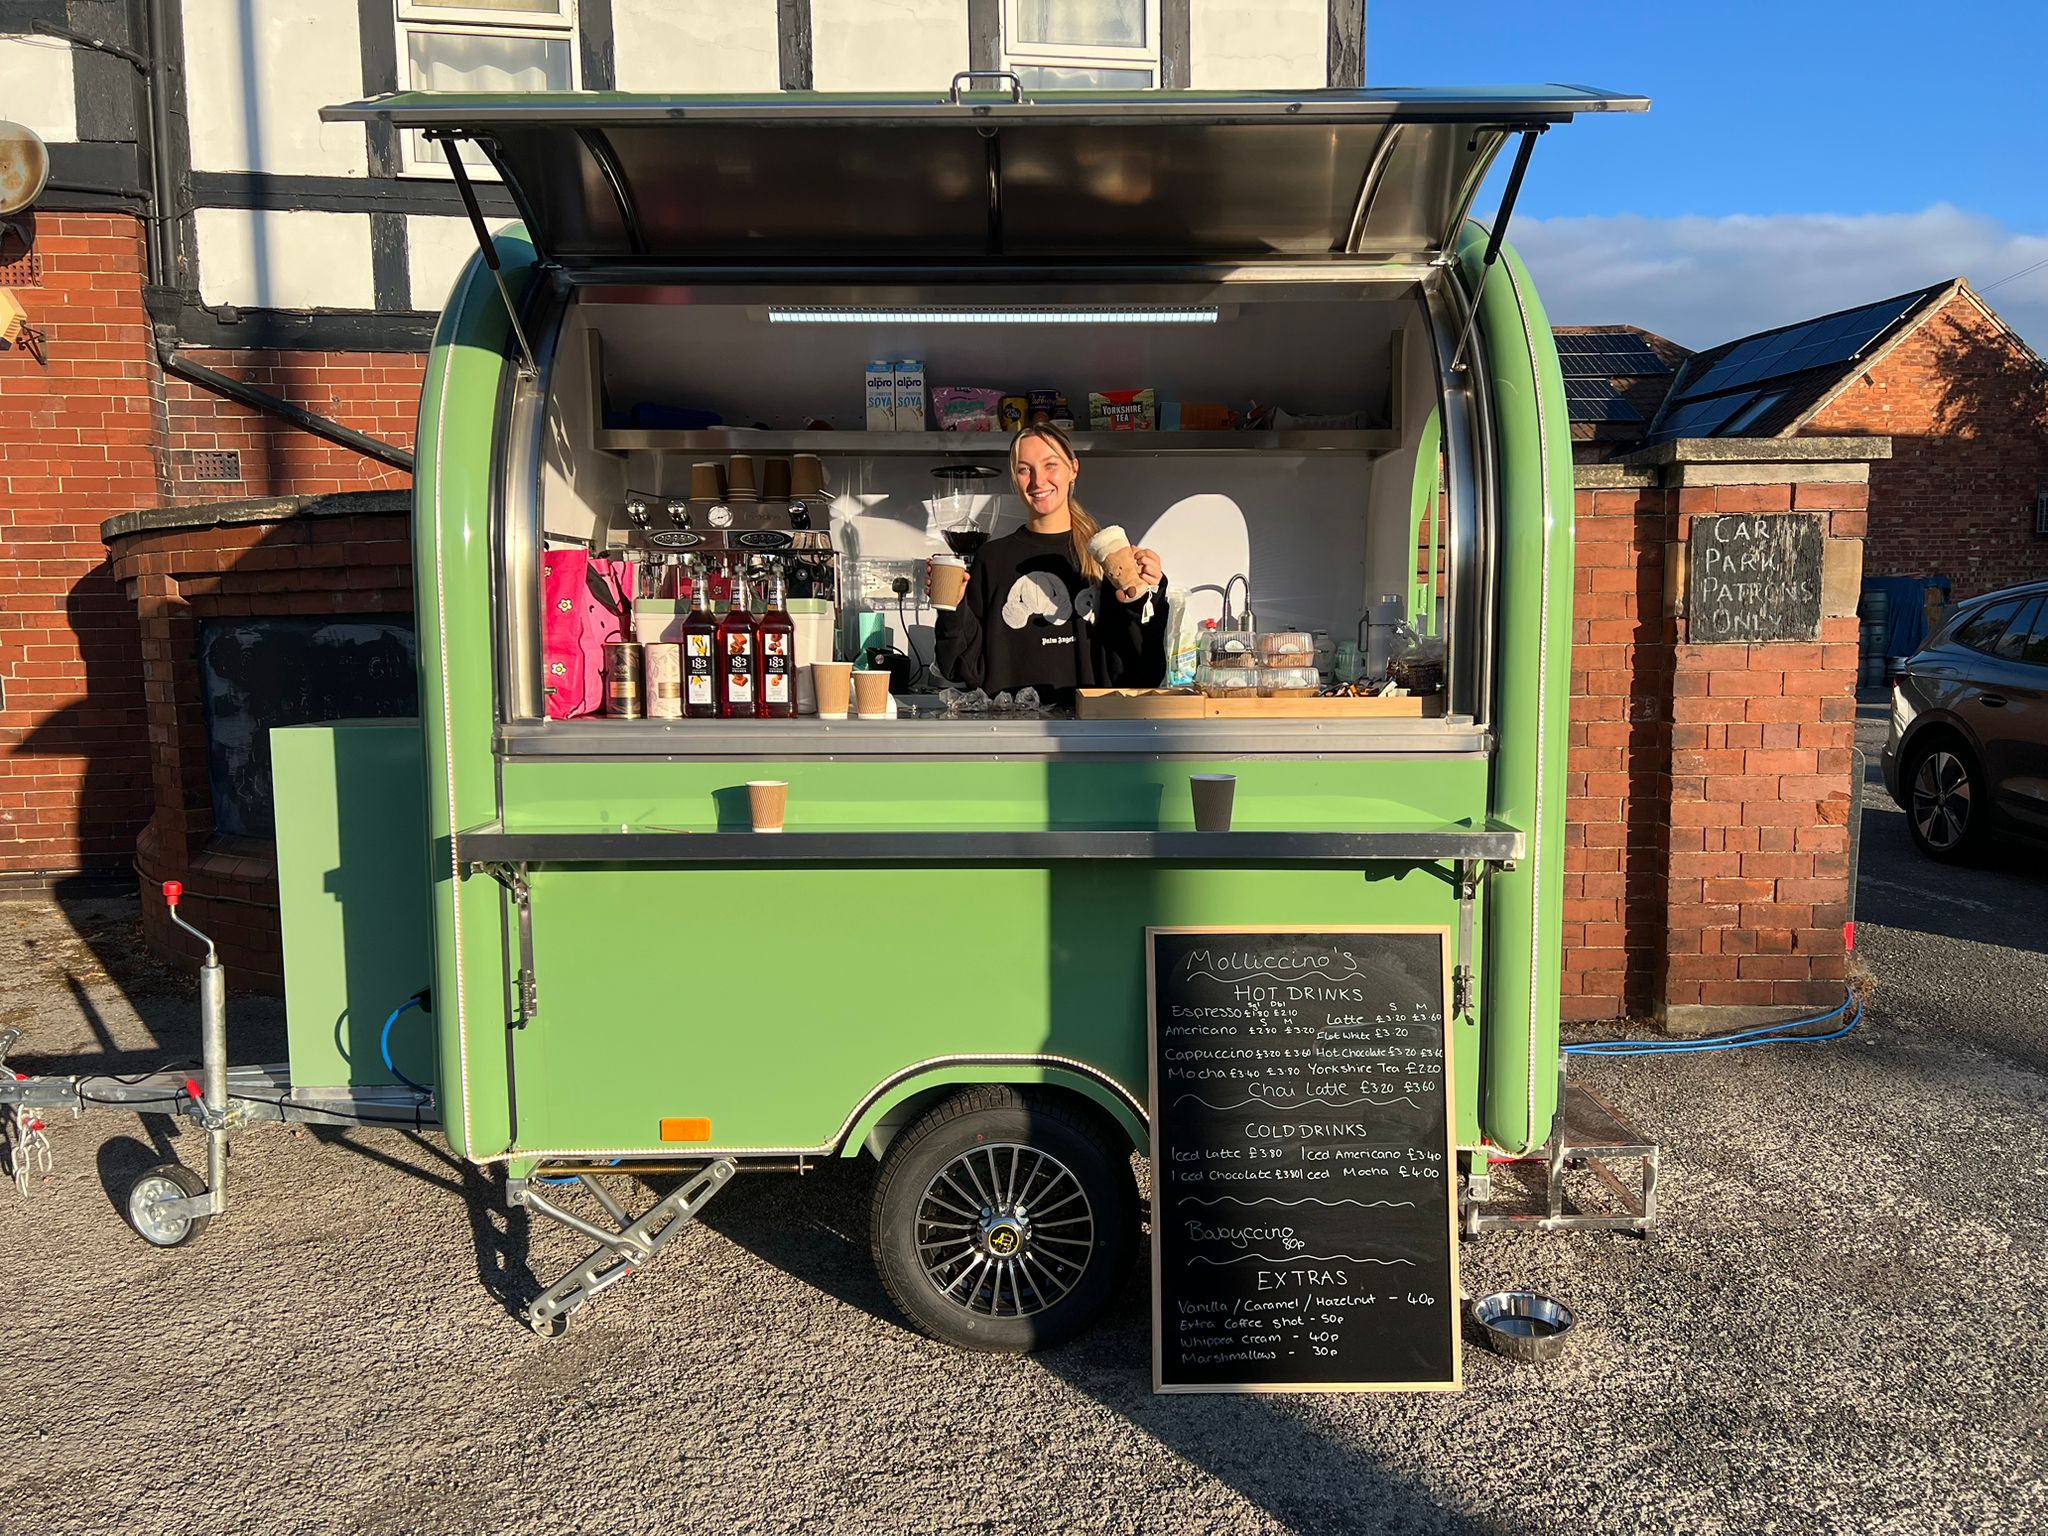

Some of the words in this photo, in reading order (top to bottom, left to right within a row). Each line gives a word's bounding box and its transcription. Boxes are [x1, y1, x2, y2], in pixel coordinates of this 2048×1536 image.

[868, 377, 892, 389] alpro
[897, 377, 922, 389] alpro
[868, 396, 892, 408] SOYA
[898, 396, 922, 408] SOYA
[1102, 404, 1142, 416] YORKSHIRE
[1116, 414, 1129, 423] TEA
[1714, 517, 1769, 542] CAR
[1705, 548, 1776, 574] PARK
[1702, 577, 1813, 603] PATRONS
[1713, 608, 1782, 634] ONLY
[1234, 985, 1278, 1001] HOT
[1287, 987, 1364, 1002] DRINKS
[1172, 1005, 1242, 1019] Espresso
[1389, 1003, 1398, 1011] S
[1260, 1019, 1268, 1027] S
[1326, 1014, 1364, 1025] Latte
[1165, 1025, 1238, 1037] Americano
[1316, 1032, 1340, 1041] Flat
[1165, 1048, 1254, 1062] Cappuccino
[1316, 1048, 1341, 1058] Hot
[1341, 1048, 1386, 1058] Chocolate
[1168, 1067, 1227, 1079] Mocha
[1307, 1062, 1372, 1075] Yorkshire
[1376, 1062, 1400, 1073] Tea
[1248, 1081, 1296, 1097] Chai
[1306, 1082, 1349, 1096] Latte
[1245, 1122, 1295, 1138] COLD
[1298, 1123, 1367, 1139] DRINKS
[1172, 1146, 1201, 1161] Iced
[1205, 1148, 1241, 1159] Latte
[1301, 1146, 1330, 1161] Iced
[1335, 1148, 1401, 1160] Americano
[1172, 1169, 1204, 1181] Iced
[1209, 1169, 1272, 1181] Chocolate
[1300, 1168, 1331, 1180] Iced
[1343, 1167, 1390, 1177] Mocha
[1184, 1220, 1294, 1249] Babyccino
[1282, 1238, 1306, 1251] 80p
[1257, 1270, 1348, 1291] EXTRAS
[1178, 1299, 1229, 1314] Vanilla
[1243, 1298, 1299, 1312] Caramel
[1407, 1292, 1435, 1306] 40p
[1180, 1319, 1217, 1331] Extra
[1320, 1313, 1344, 1325] 50p
[1309, 1331, 1339, 1342] 40p
[1182, 1350, 1277, 1365] Marshmallows
[1312, 1346, 1338, 1357] 30p
